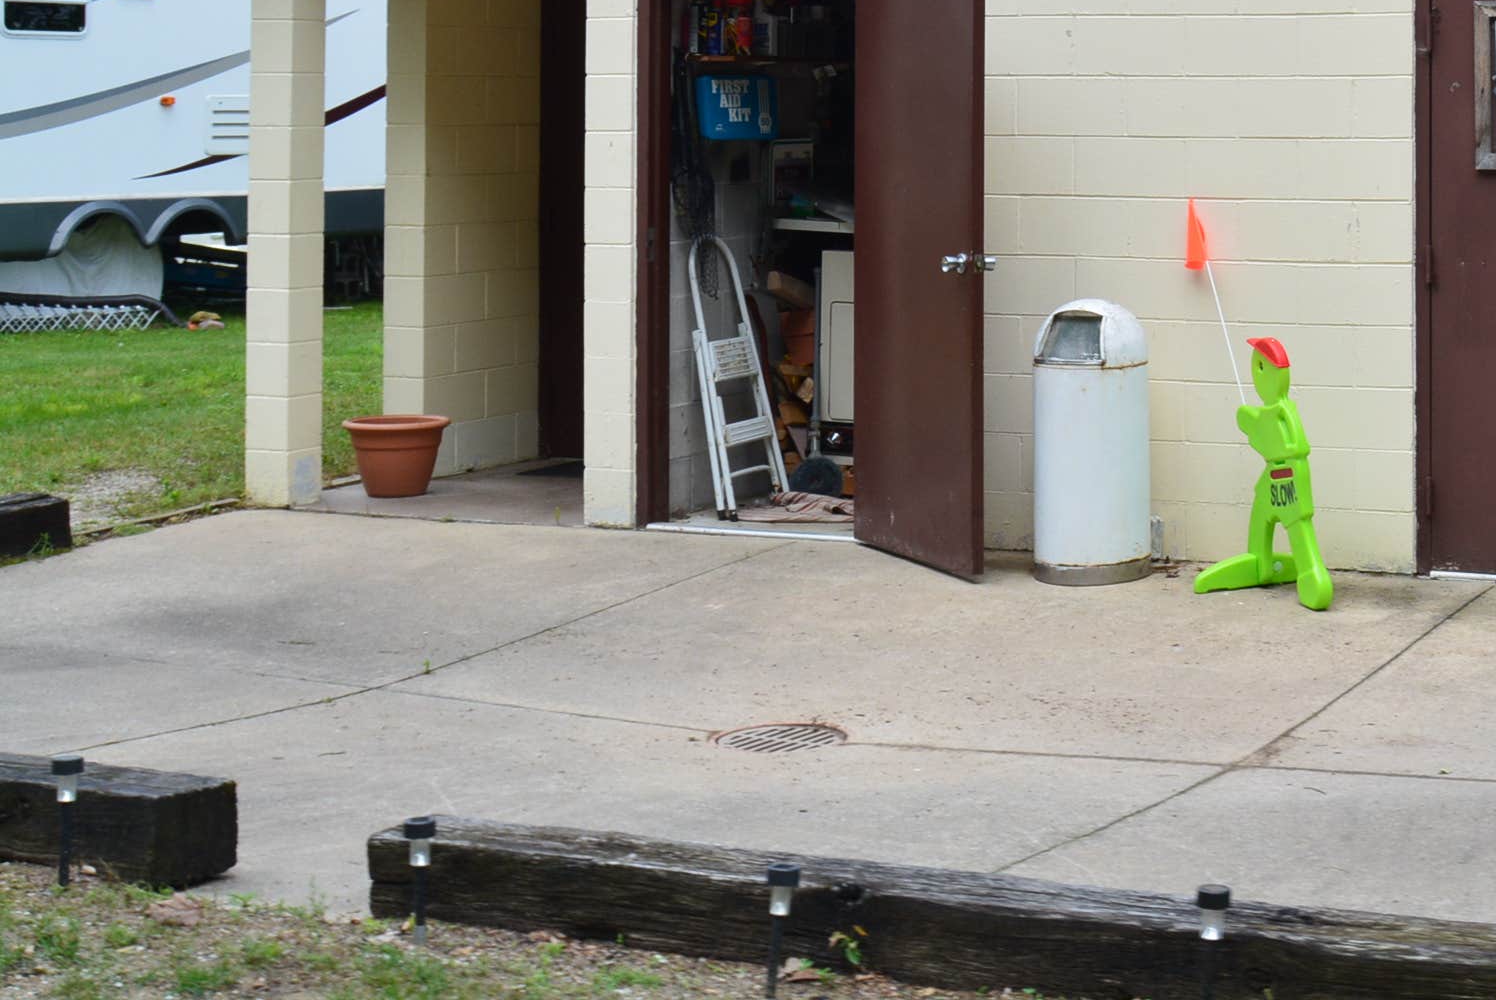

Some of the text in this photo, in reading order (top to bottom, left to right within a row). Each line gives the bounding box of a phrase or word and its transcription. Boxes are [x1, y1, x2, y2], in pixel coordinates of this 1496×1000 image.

[711, 79, 749, 93] FIRST
[720, 94, 741, 107] AID
[728, 108, 751, 122] KIT
